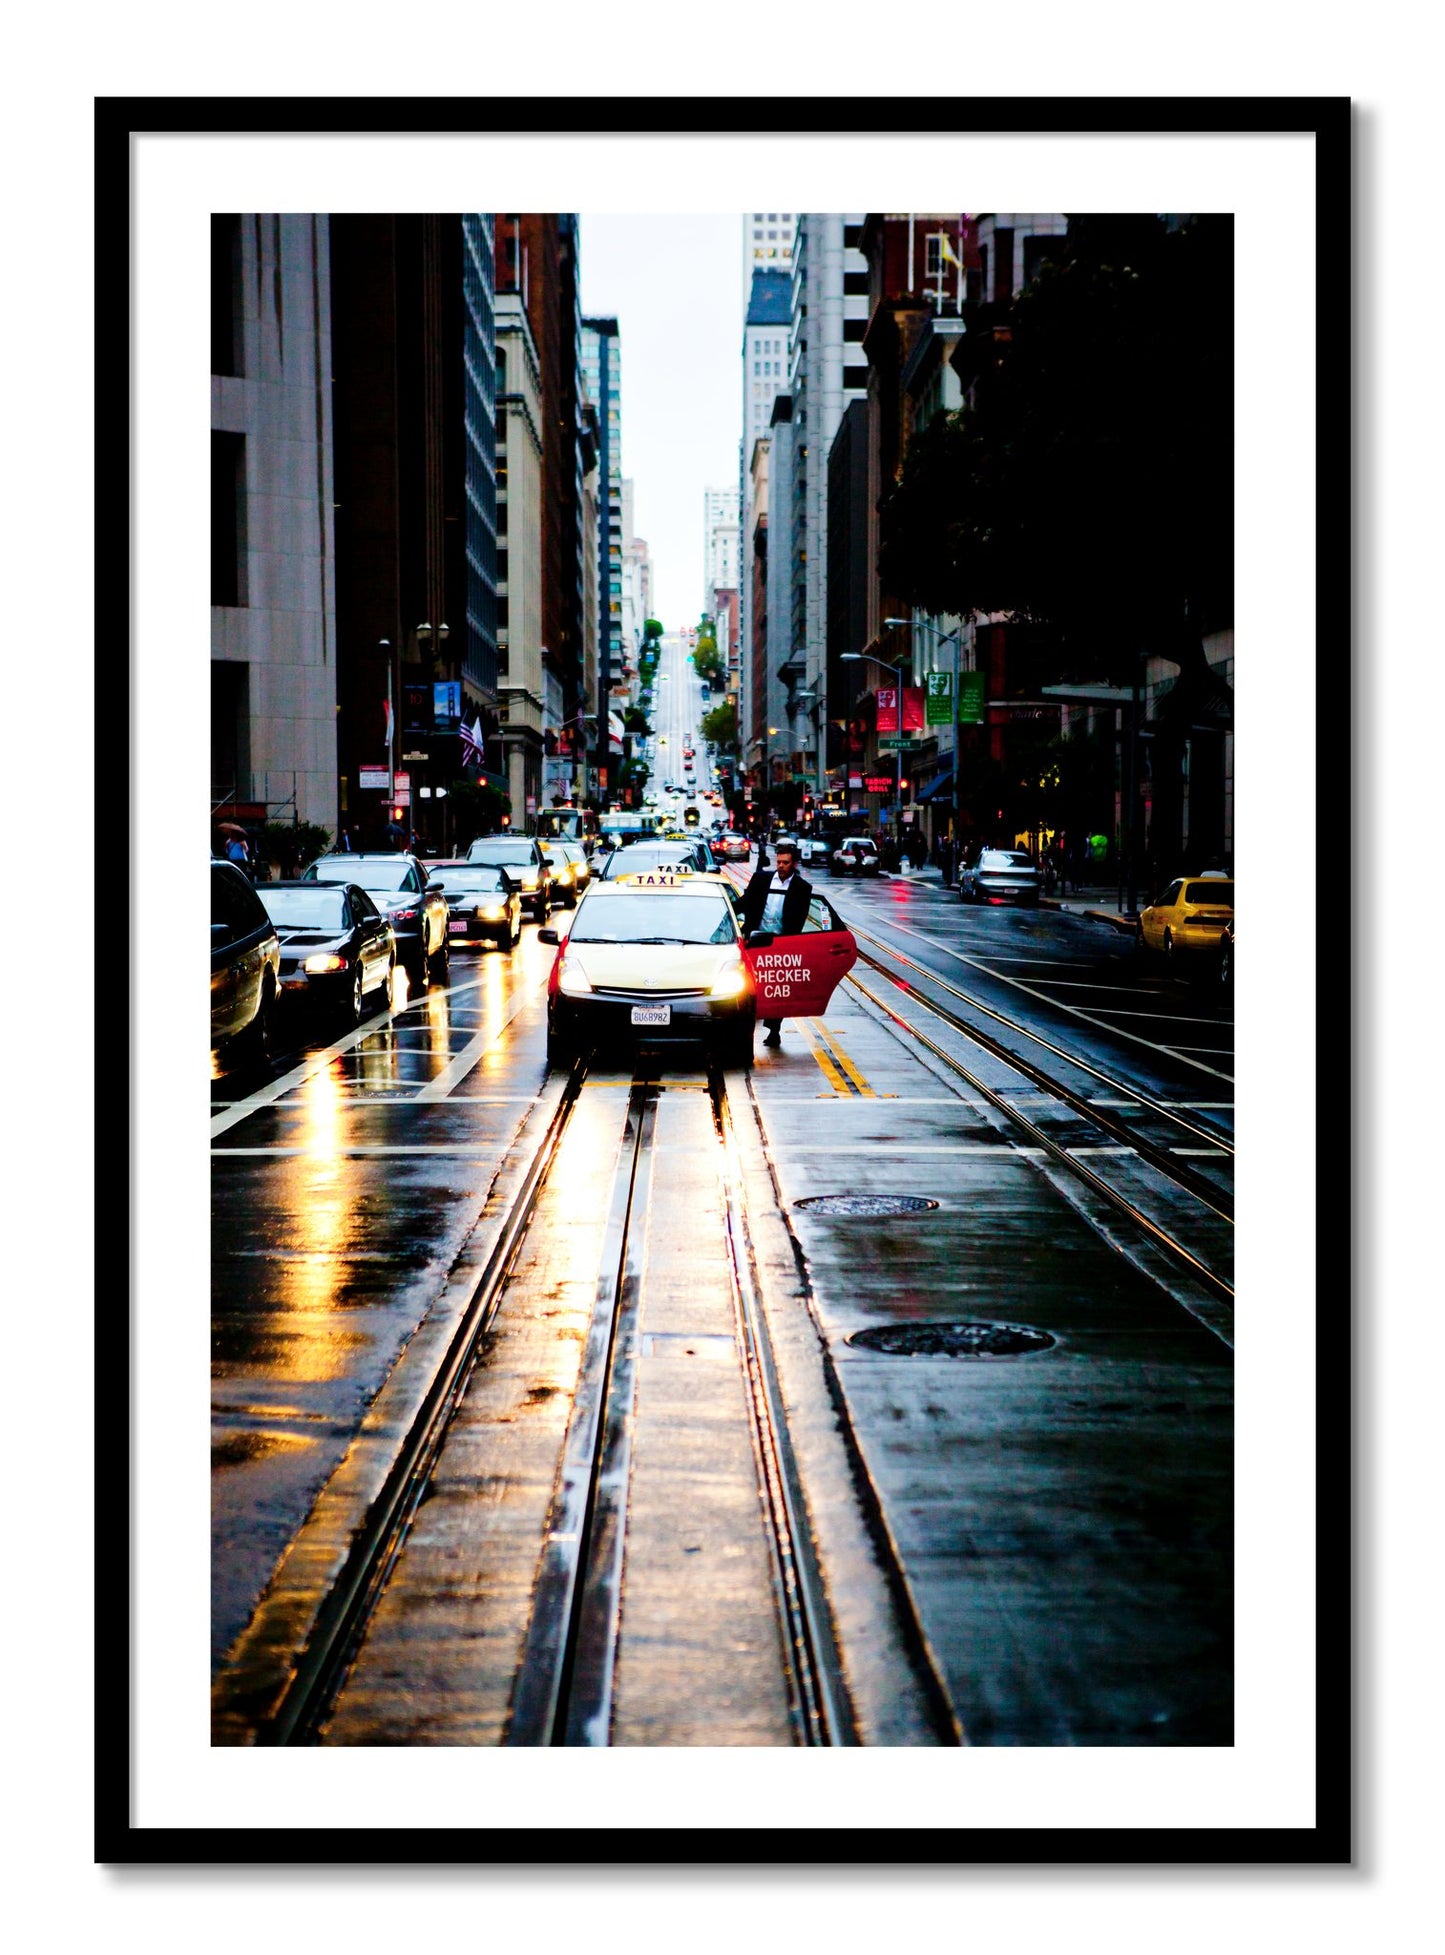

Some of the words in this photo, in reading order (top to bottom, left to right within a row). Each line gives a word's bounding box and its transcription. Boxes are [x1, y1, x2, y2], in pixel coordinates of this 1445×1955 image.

[889, 740, 911, 748] Front
[867, 785, 889, 793] GRILL
[657, 865, 688, 873] TAXI
[636, 875, 674, 885] TAXI
[756, 954, 802, 968] ARROW
[764, 984, 791, 998] CAB
